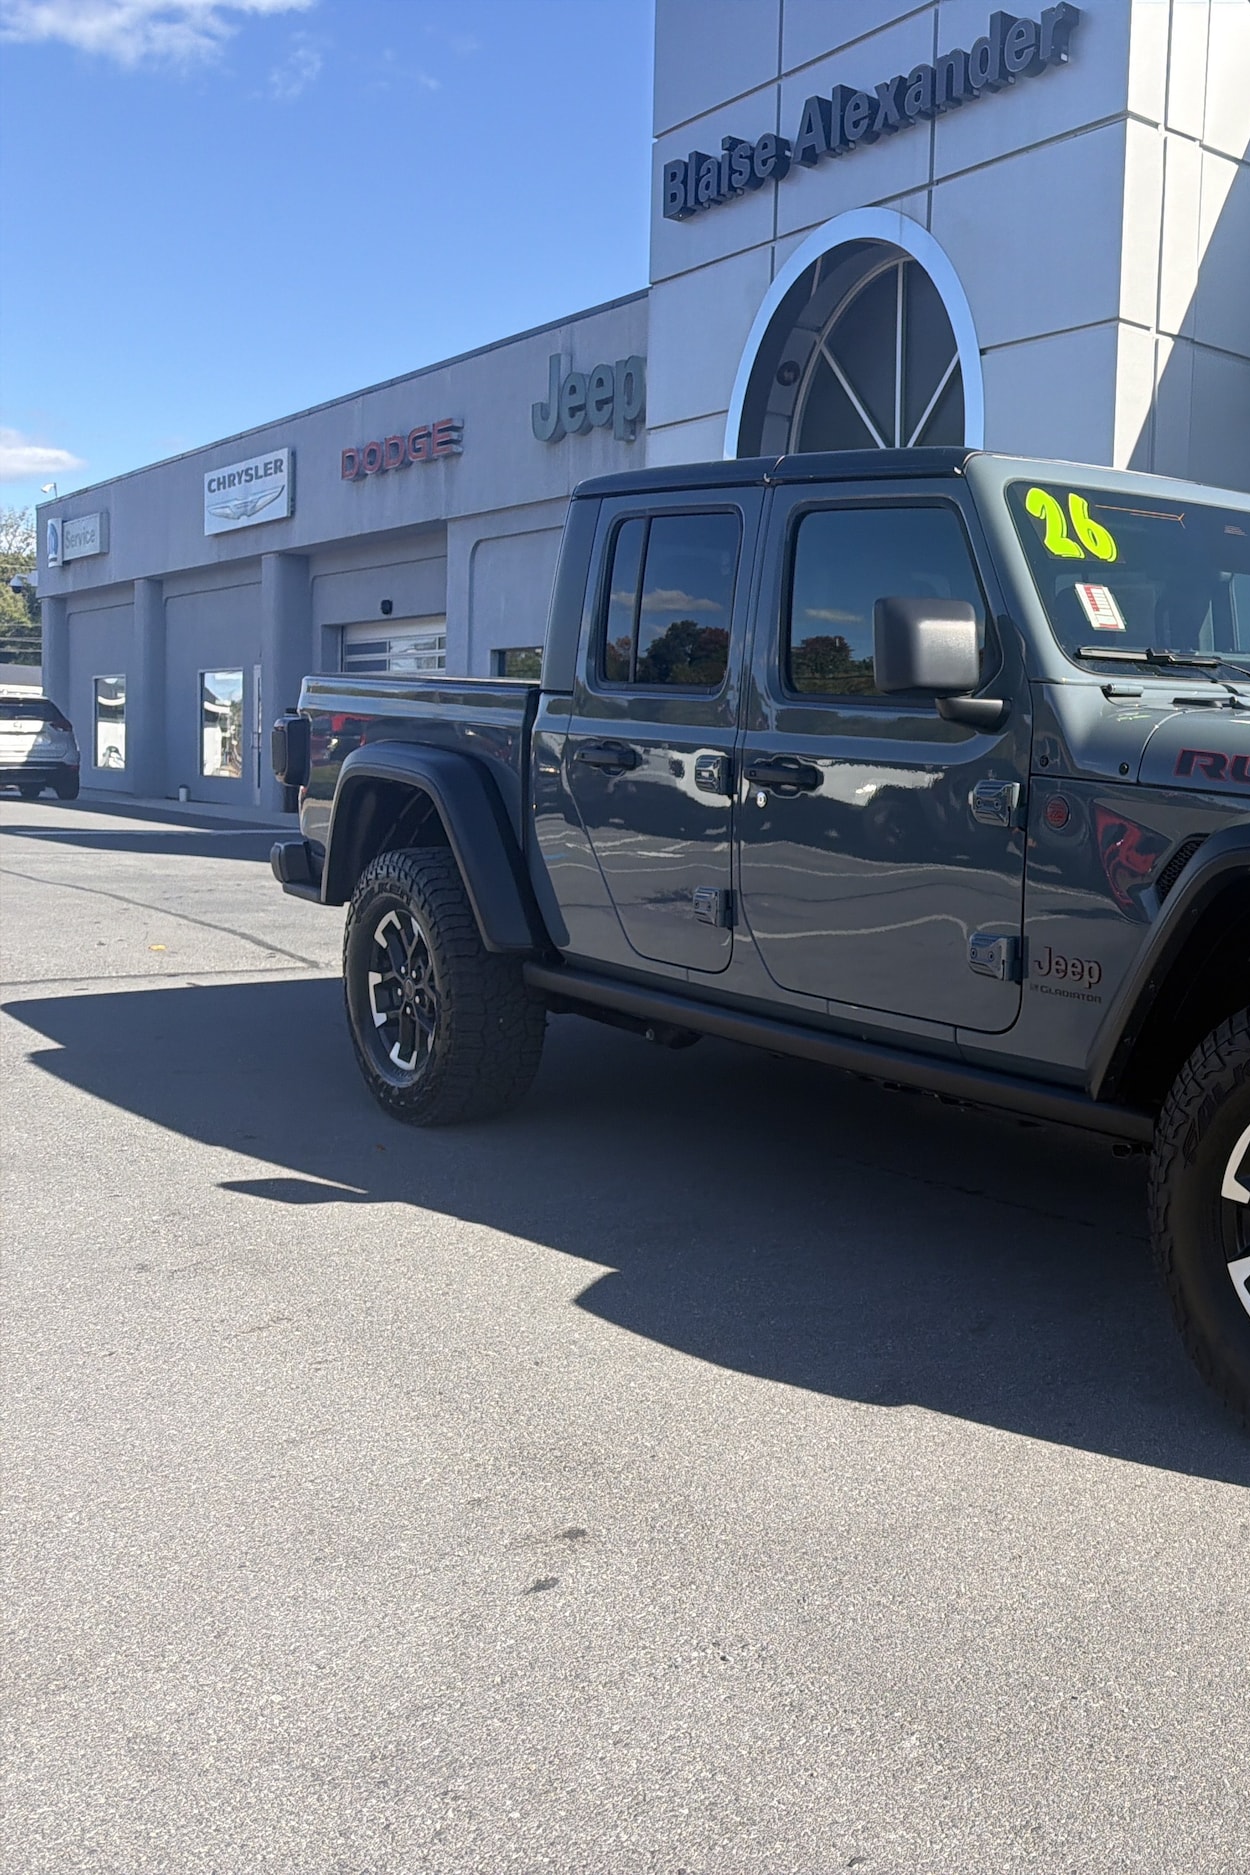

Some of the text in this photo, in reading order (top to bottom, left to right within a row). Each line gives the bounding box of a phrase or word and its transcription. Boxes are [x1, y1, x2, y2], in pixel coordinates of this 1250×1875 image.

[663, 2, 1079, 221] Blaise Alexander
[531, 353, 647, 442] Jeep
[206, 457, 285, 494] CHRYSLER
[341, 417, 463, 481] DODGE
[64, 526, 96, 550] Service
[1025, 487, 1117, 563] 26
[1032, 946, 1102, 990] Jeep
[1039, 985, 1102, 1004] GLADIATOR
